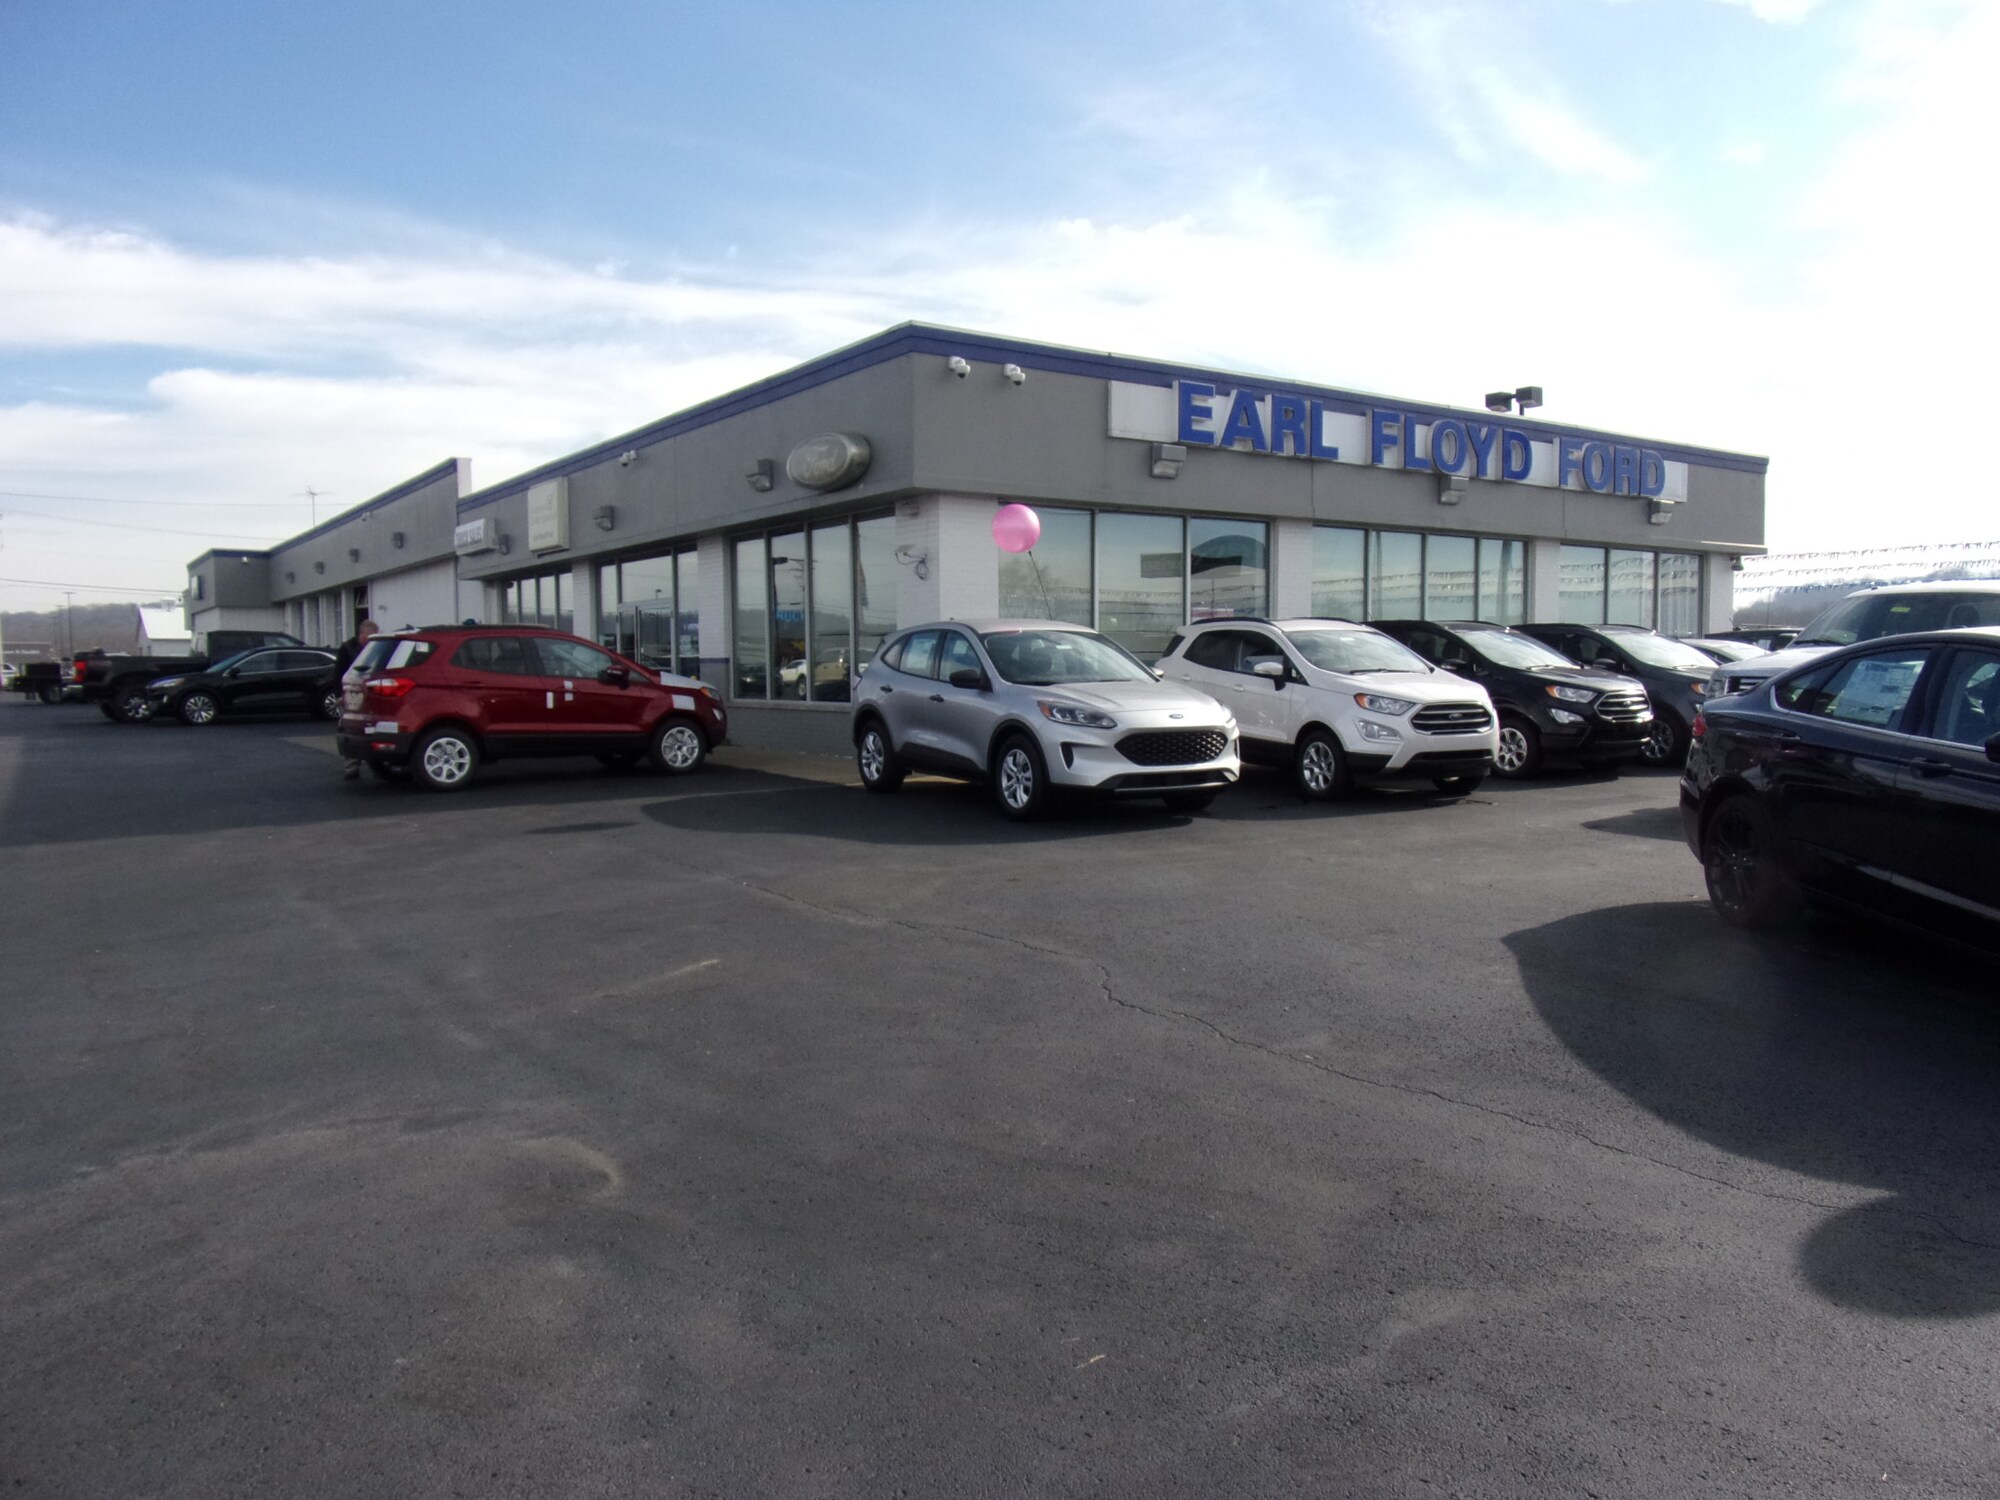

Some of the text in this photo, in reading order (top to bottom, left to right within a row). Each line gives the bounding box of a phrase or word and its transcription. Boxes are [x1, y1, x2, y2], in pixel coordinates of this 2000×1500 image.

[1174, 379, 1666, 497] EARL FLOYD FORD
